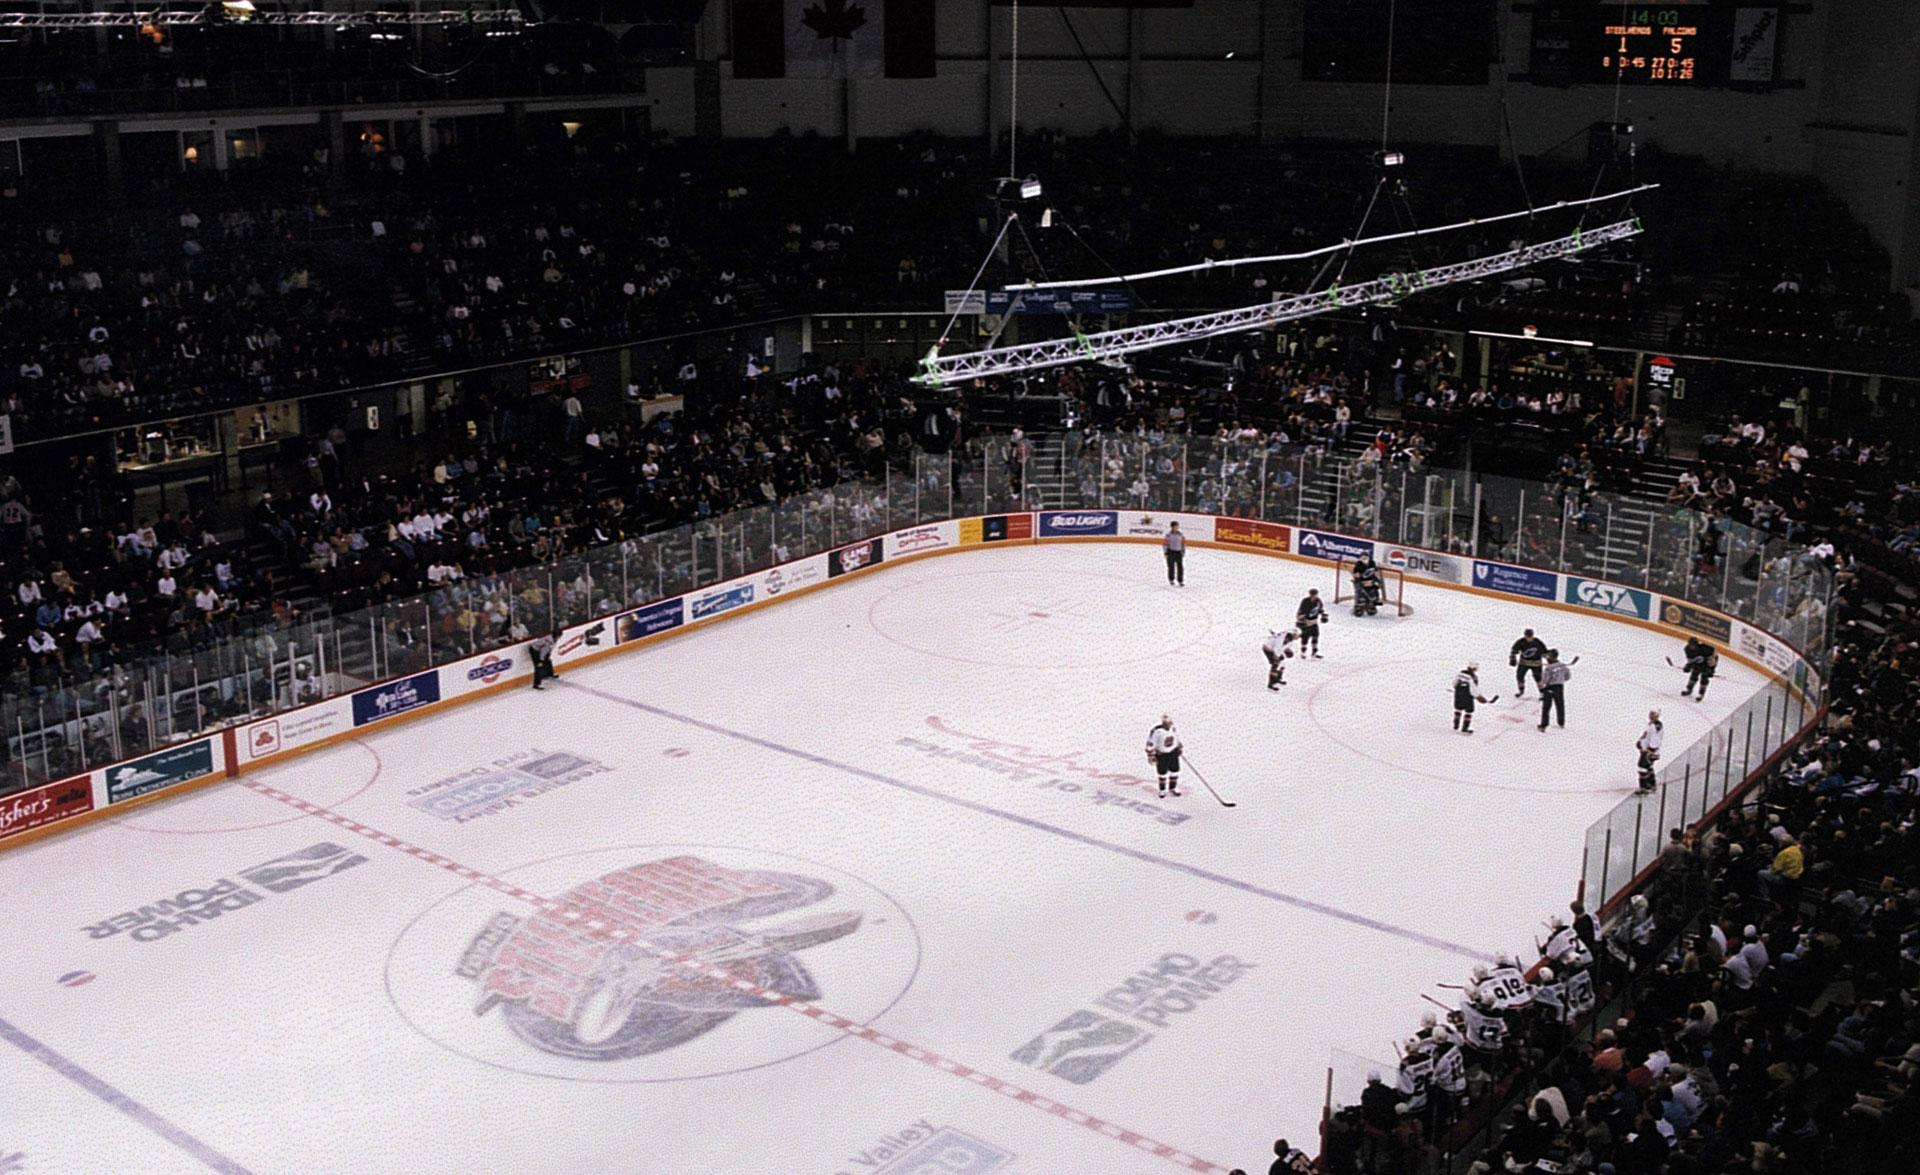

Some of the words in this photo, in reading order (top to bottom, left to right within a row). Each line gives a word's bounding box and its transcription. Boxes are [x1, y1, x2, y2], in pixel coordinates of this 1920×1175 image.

[1631, 10, 1678, 25] 14:03
[1618, 36, 1627, 52] 1
[1671, 38, 1682, 54] 5
[1651, 57, 1665, 68] 27
[1667, 57, 1695, 68] 0:45
[1651, 68, 1665, 79] 10
[1051, 515, 1076, 526] BUD
[1076, 515, 1111, 526] LIGHT
[1408, 556, 1441, 573] ONE
[80, 878, 243, 939] POWER
[130, 889, 266, 942] IDAHO
[1093, 952, 1200, 1016] IDAHO
[1134, 954, 1258, 1028] POWER
